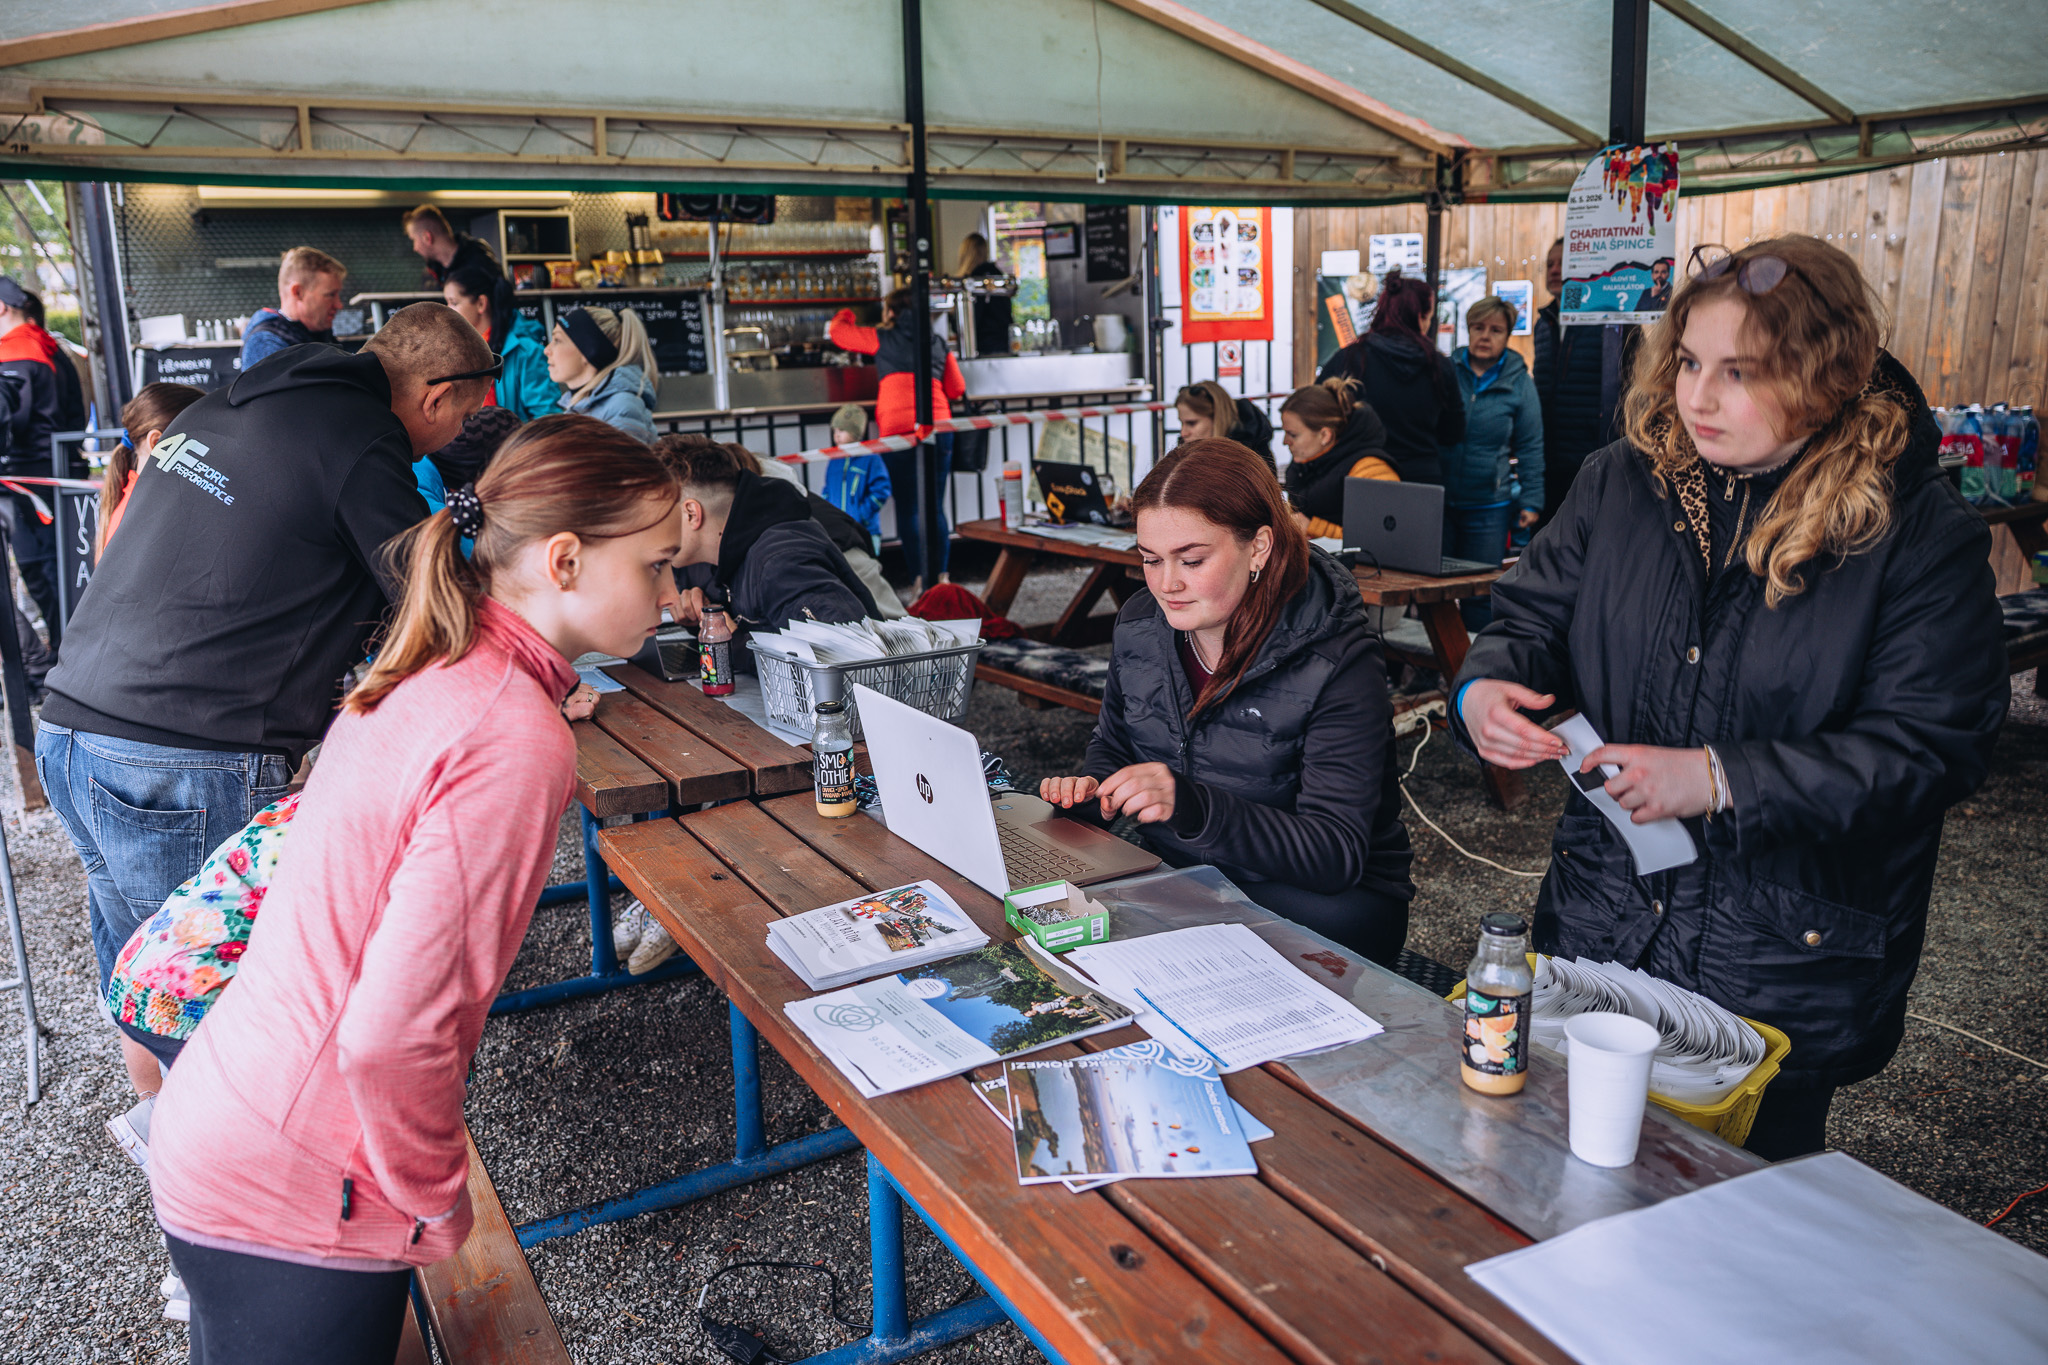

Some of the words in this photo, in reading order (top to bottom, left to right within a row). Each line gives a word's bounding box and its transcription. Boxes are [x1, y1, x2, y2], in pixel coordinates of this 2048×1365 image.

[1586, 194, 1602, 203] 2026
[1570, 224, 1644, 239] CHARITATIVNÍ
[1570, 241, 1590, 252] BĚH
[1593, 241, 1607, 251] NA
[1609, 238, 1654, 251] ŠPINCE
[1602, 283, 1645, 291] KALKULÁTOR
[150, 432, 210, 473] 4F
[193, 461, 230, 489] SPORT
[172, 463, 235, 506] PERFORMANCE
[821, 768, 849, 785] OTHIE
[917, 772, 933, 804] hp
[1078, 1058, 1153, 1069] KLADSKÉ
